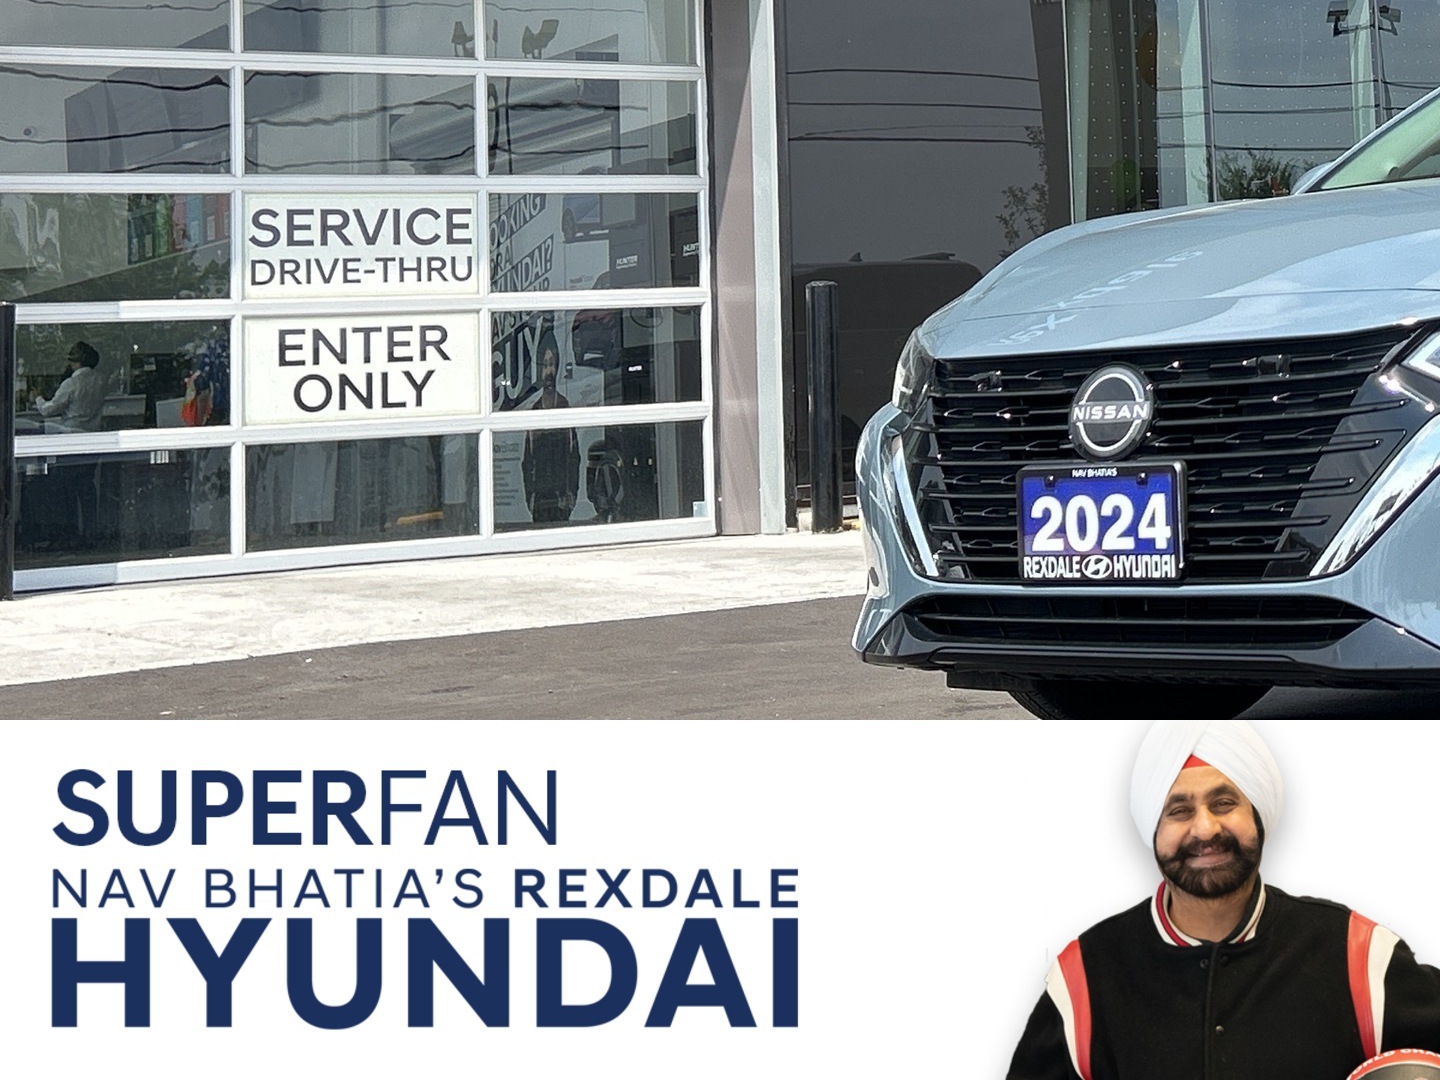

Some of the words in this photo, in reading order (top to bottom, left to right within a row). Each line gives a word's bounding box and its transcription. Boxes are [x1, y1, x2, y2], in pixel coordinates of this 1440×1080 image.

[249, 207, 472, 248] SERVICE
[250, 256, 473, 286] DRIVE-THRU
[278, 325, 452, 367] ENTER
[293, 369, 436, 413] ONLY
[1073, 403, 1149, 421] NISSAN
[1030, 492, 1172, 553] 2024
[1023, 555, 1082, 579] REXDALE
[1113, 554, 1176, 578] HYUNDAI
